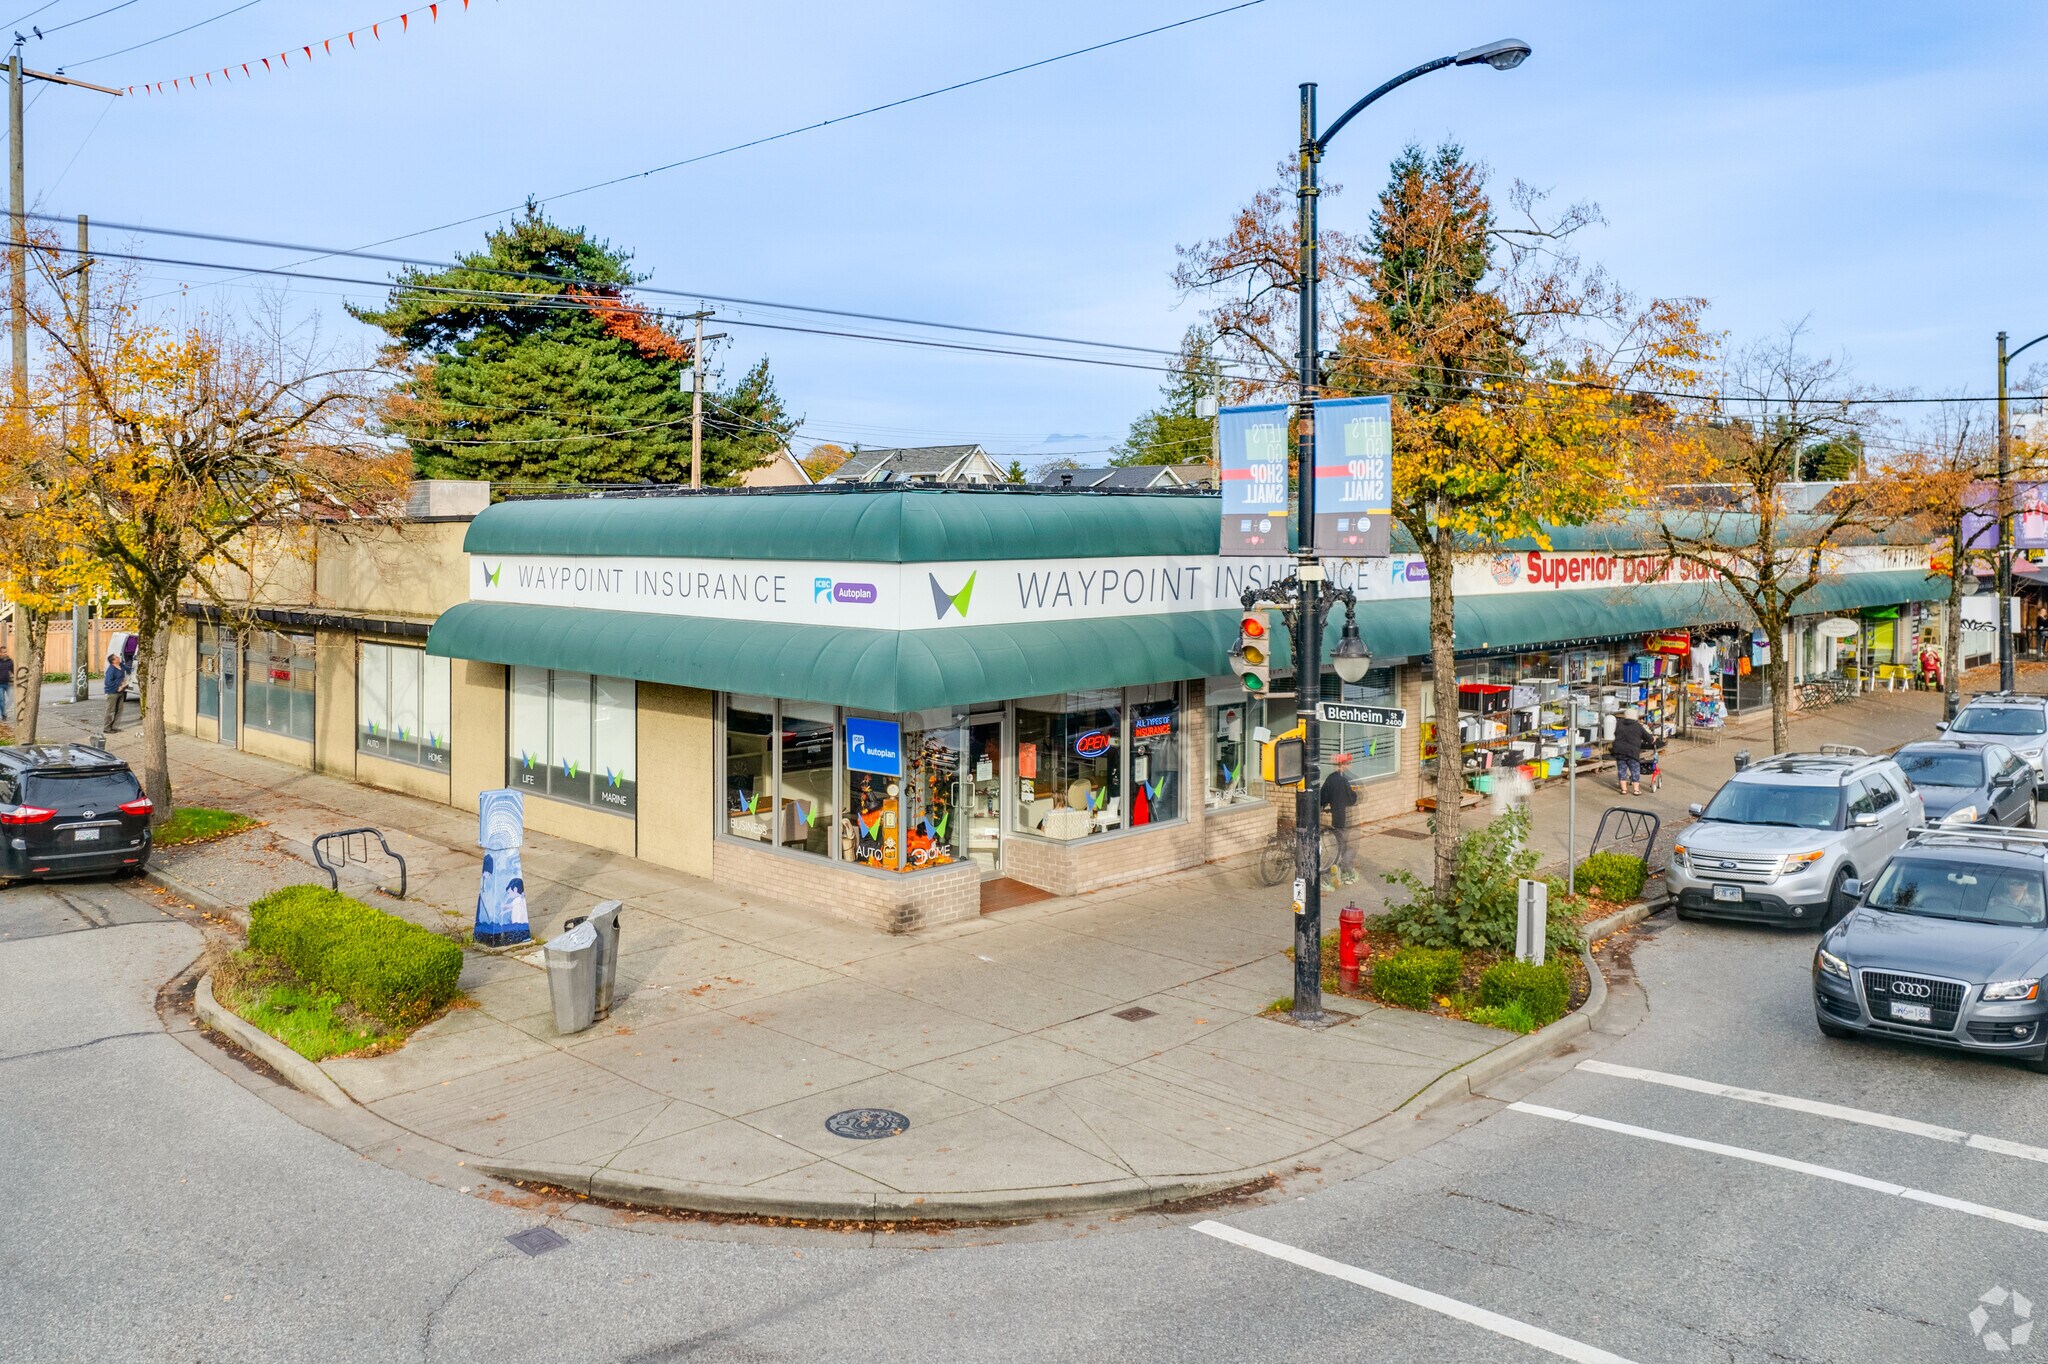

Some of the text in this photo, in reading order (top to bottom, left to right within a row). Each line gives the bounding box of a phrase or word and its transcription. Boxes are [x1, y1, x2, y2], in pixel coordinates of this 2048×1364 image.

[1527, 550, 1617, 589] Superior
[518, 565, 787, 603] WAYPOINT INSURANCE
[815, 580, 831, 588] ICBC
[1017, 566, 1202, 609] WAYPOINT
[838, 587, 872, 600] Autoplan
[1135, 716, 1171, 728] ALL TYPES OF
[1327, 706, 1383, 724] Blenheim
[1134, 724, 1171, 738] INSURANCE
[366, 739, 380, 749] AUTO
[1077, 735, 1111, 752] OPEN
[427, 752, 443, 764] HOME
[866, 747, 896, 759] autoplan
[522, 773, 535, 785] LIFE
[601, 791, 627, 806] MARINE
[730, 817, 768, 836] BUSINESS
[855, 845, 883, 861] AUTO
[921, 844, 951, 861] HOME
